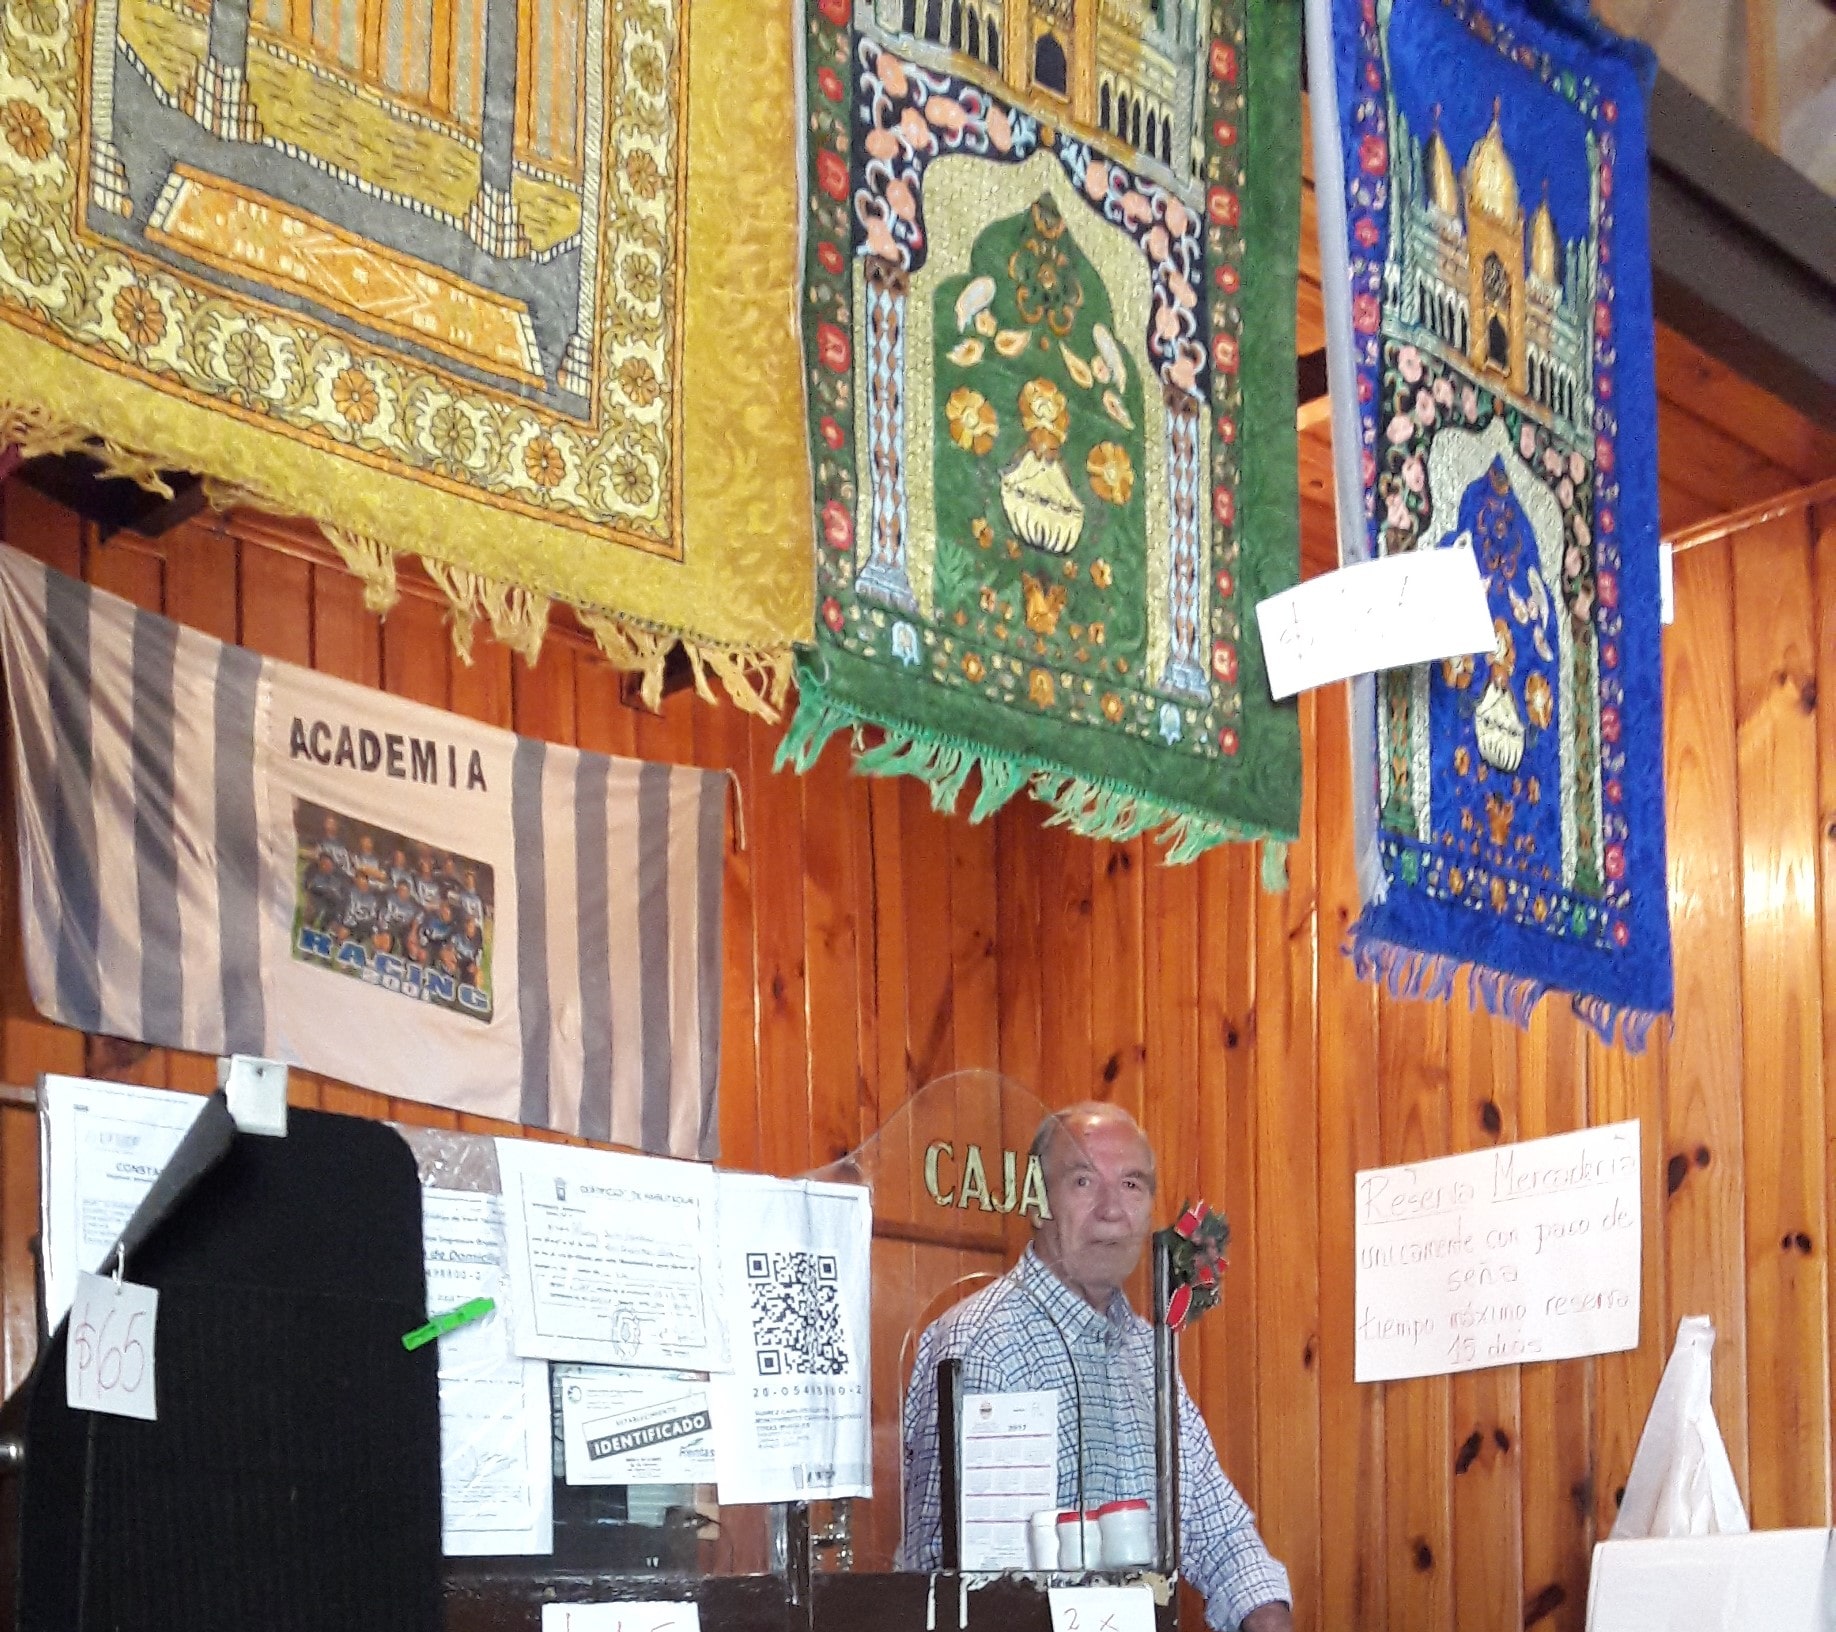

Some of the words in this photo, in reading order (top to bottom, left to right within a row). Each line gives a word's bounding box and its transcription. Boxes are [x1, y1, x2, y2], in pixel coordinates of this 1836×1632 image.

[289, 716, 488, 792] ACADEMIA
[299, 927, 490, 1012] RACING
[924, 1139, 1054, 1220] CAJA
[1486, 1228, 1519, 1250] con
[1602, 1197, 1635, 1229] de
[1358, 1305, 1435, 1346] tiempo
[593, 1415, 706, 1457] IDENTIFICADO
[1064, 1607, 1080, 1631] 2
